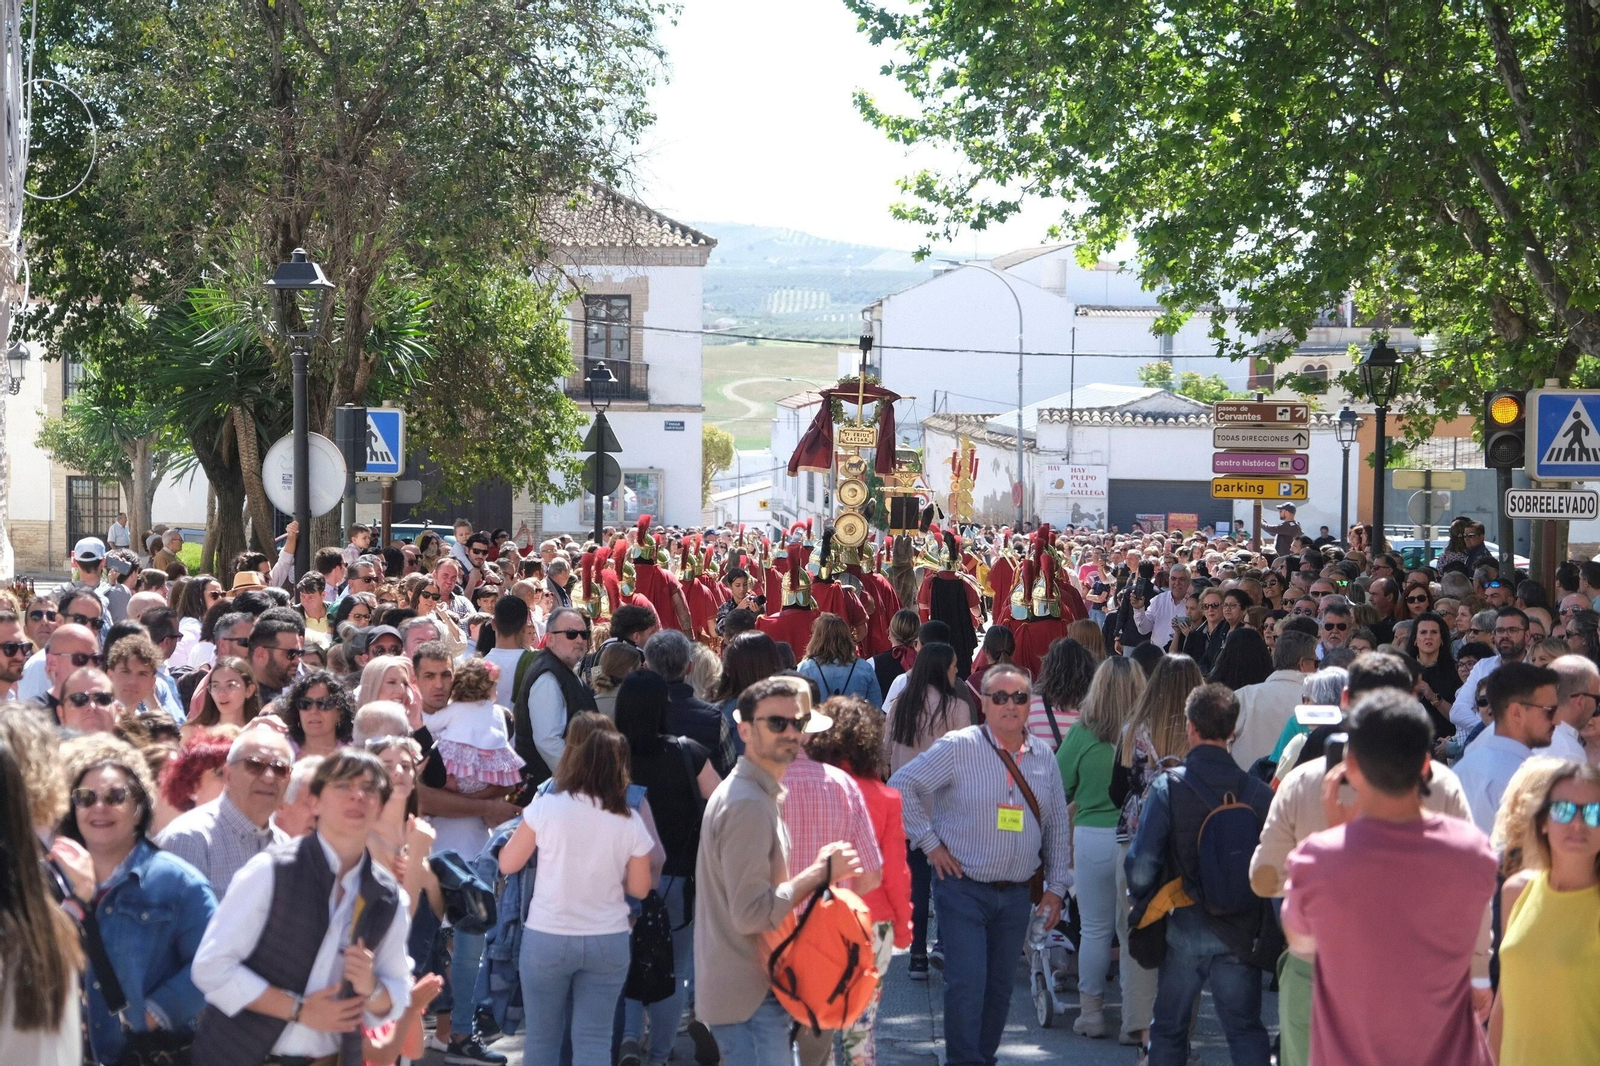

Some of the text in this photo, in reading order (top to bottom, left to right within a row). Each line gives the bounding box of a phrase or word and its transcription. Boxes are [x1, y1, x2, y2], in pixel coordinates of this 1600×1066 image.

[1217, 412, 1262, 421] Cervantes
[1215, 459, 1276, 467] centro histórico
[1214, 482, 1264, 494] parking
[1279, 483, 1290, 496] P
[1509, 494, 1595, 514] SOBREELEVADO
